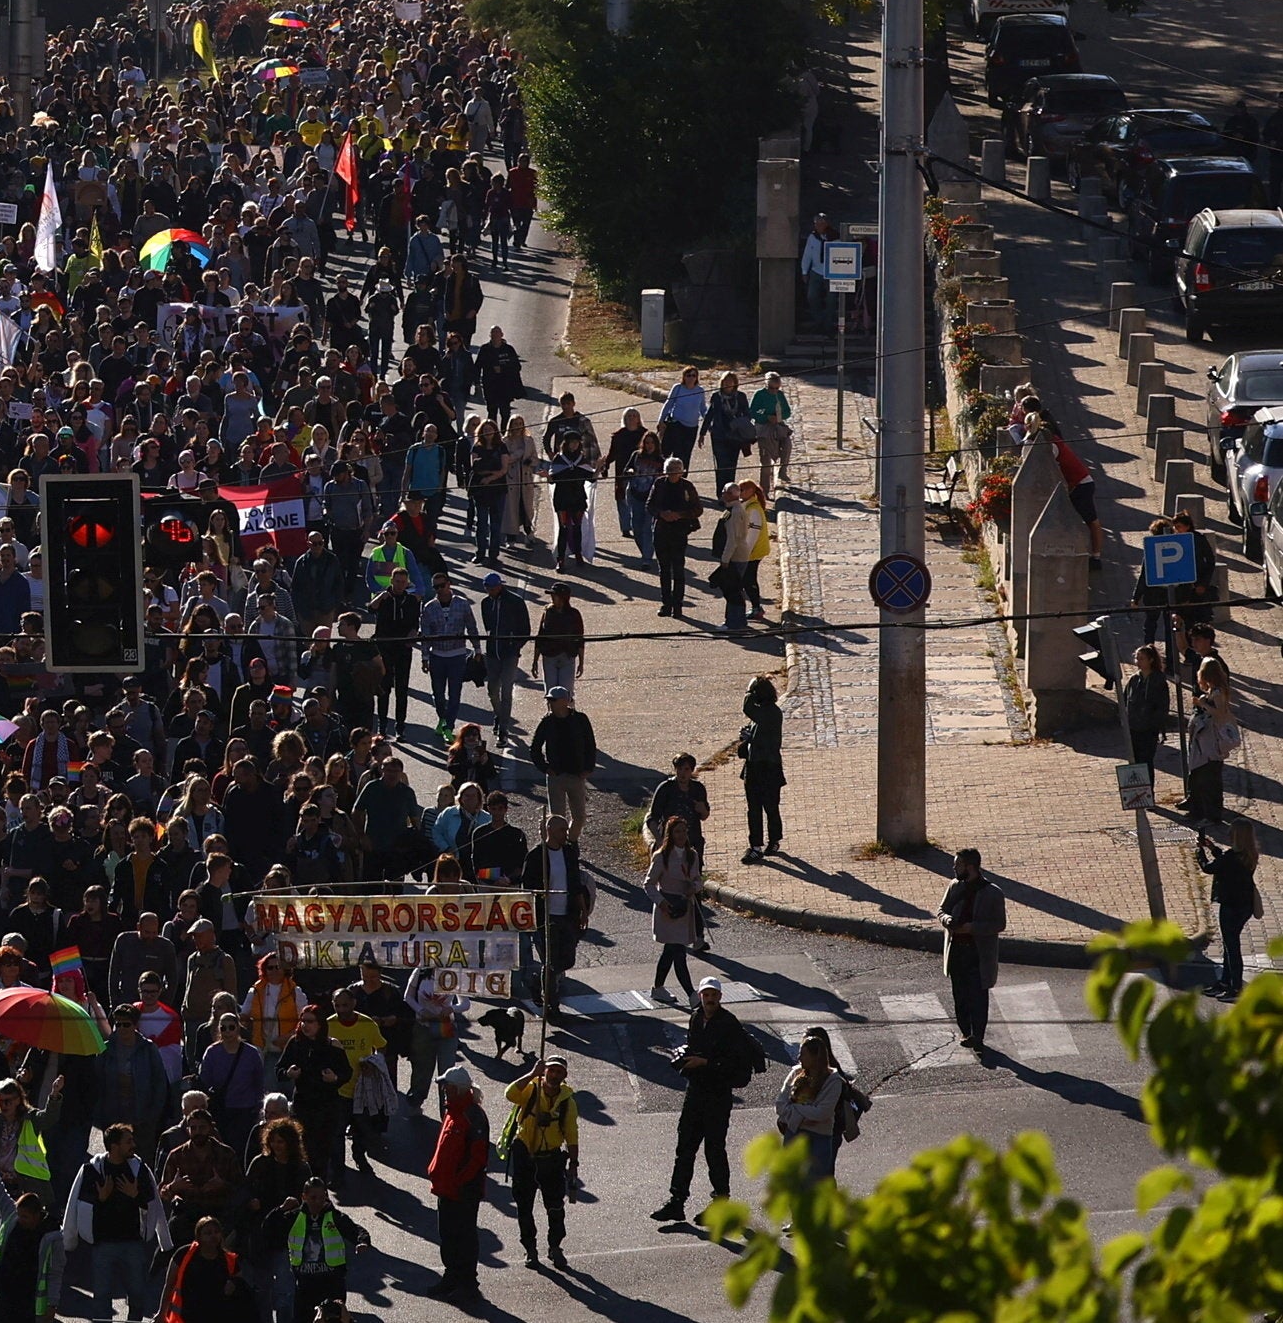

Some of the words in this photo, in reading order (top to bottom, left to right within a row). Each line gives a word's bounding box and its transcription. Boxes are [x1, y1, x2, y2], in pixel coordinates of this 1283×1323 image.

[245, 506, 272, 519] LOVE
[244, 513, 299, 533] ALONE
[1154, 541, 1184, 579] P
[125, 649, 137, 660] 23
[256, 896, 533, 932] MAGYARORSZÁG
